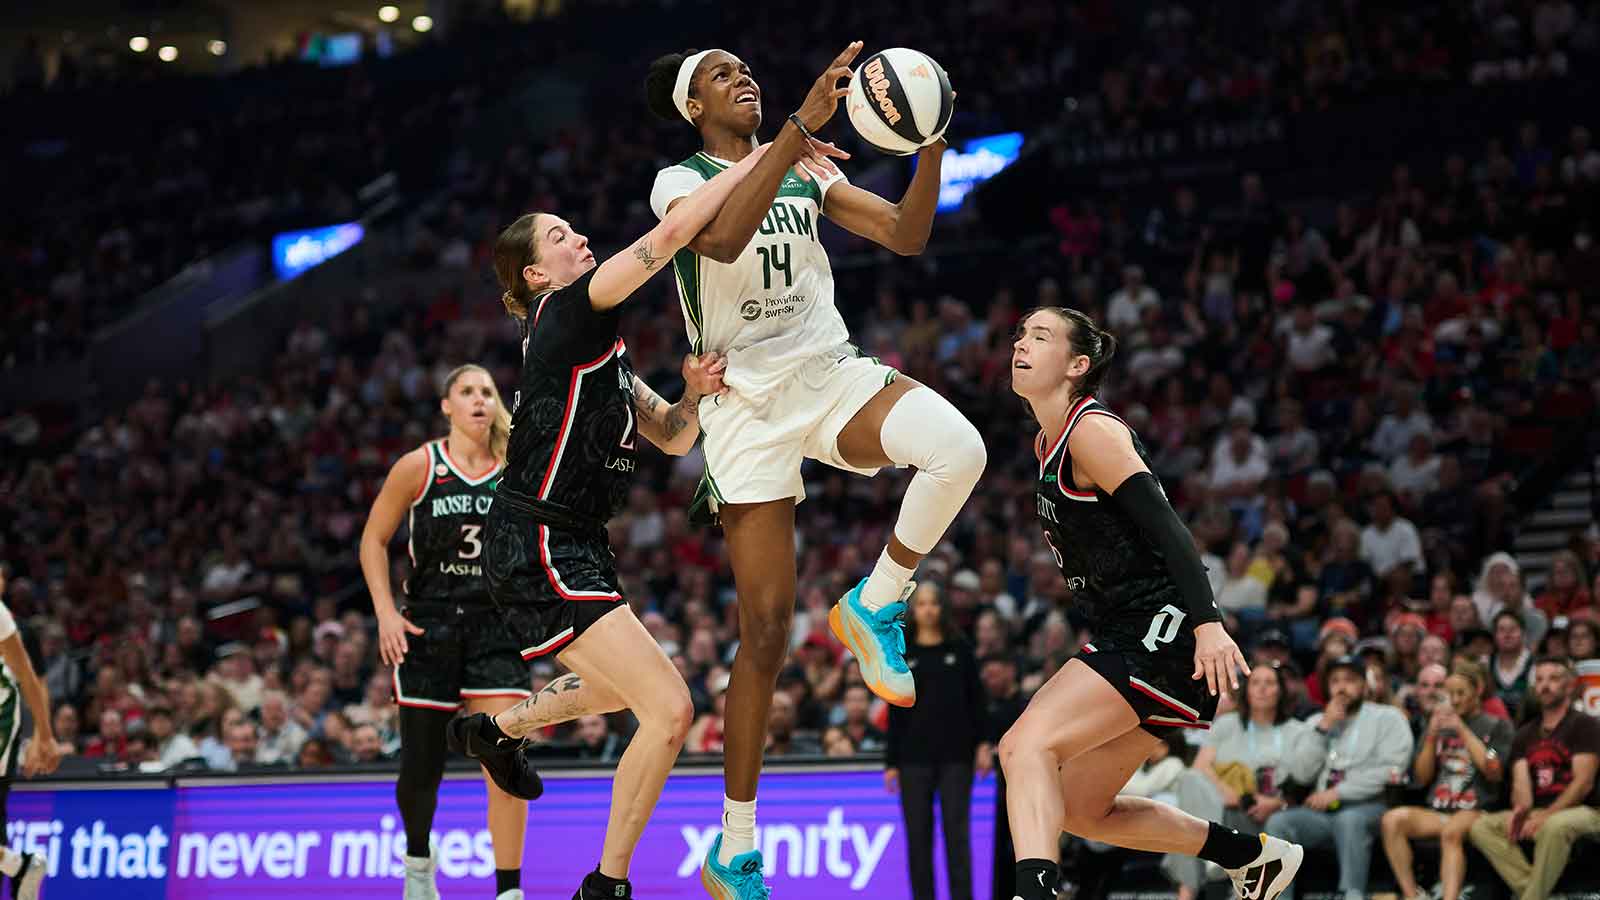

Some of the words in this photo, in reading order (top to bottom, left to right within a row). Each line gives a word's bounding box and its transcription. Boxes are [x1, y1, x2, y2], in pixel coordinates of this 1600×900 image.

[864, 57, 901, 126] Wilson
[756, 242, 792, 289] 14
[432, 494, 473, 518] ROSE
[458, 523, 482, 560] 3
[6, 819, 64, 878] iFi
[70, 819, 169, 879] that
[176, 831, 321, 879] never
[328, 813, 497, 879] mises
[676, 806, 896, 891] xnity
